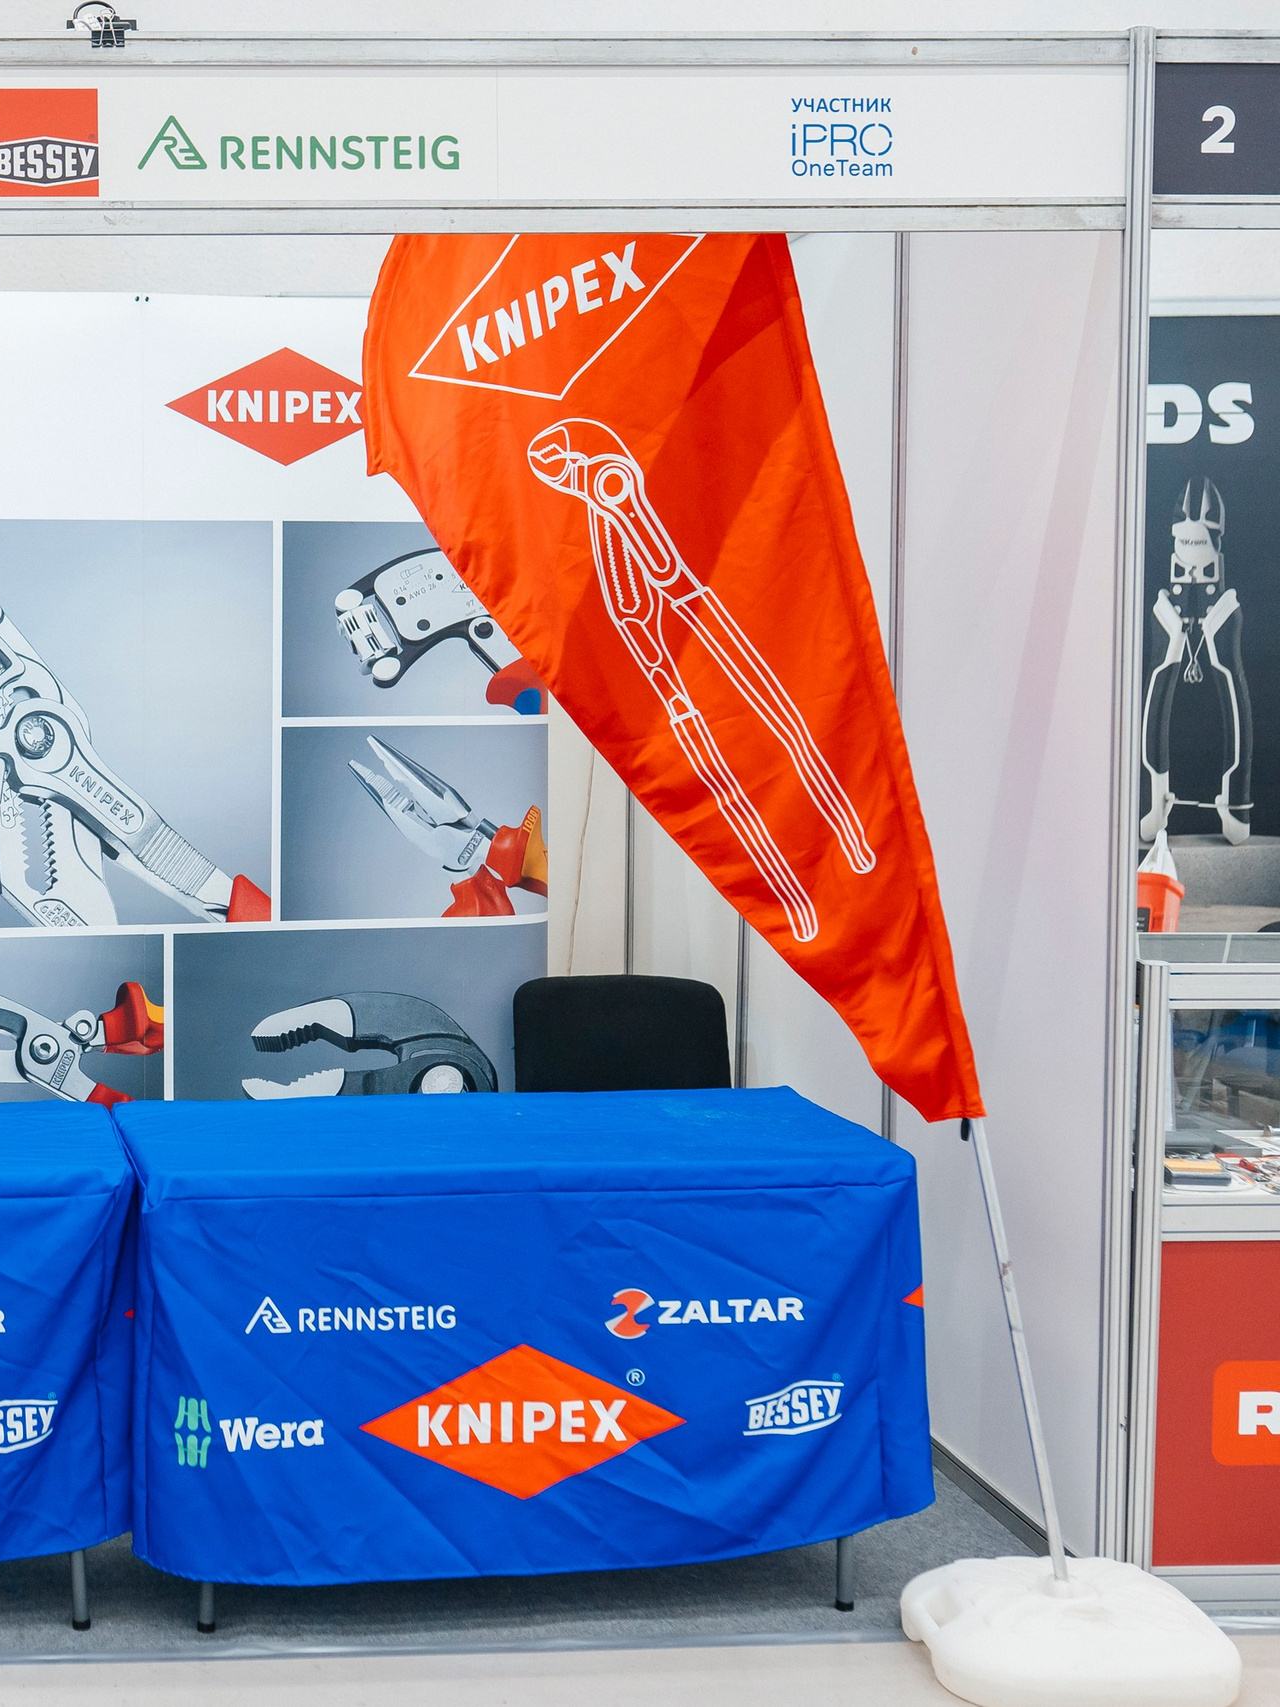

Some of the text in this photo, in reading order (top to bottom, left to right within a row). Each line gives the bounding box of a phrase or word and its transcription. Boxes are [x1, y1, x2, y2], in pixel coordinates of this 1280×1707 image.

[791, 97, 892, 113] УЧАСТНИК
[791, 122, 893, 157] iPRO
[1199, 104, 1237, 154] 2
[220, 134, 461, 170] RENNSTEIG
[791, 158, 894, 178] OneTeam
[456, 240, 647, 372] KNIPEX
[207, 388, 363, 424] KNIPEX
[408, 588, 427, 600] AWG
[2, 806, 18, 822] 52
[69, 765, 136, 827] KNIPEX
[298, 1304, 457, 1332] RENNSTEIG
[658, 1295, 805, 1325] ZALTAR
[417, 1399, 628, 1448] KNIPEX
[747, 1387, 841, 1427] BESSEY
[220, 1416, 325, 1453] Wera
